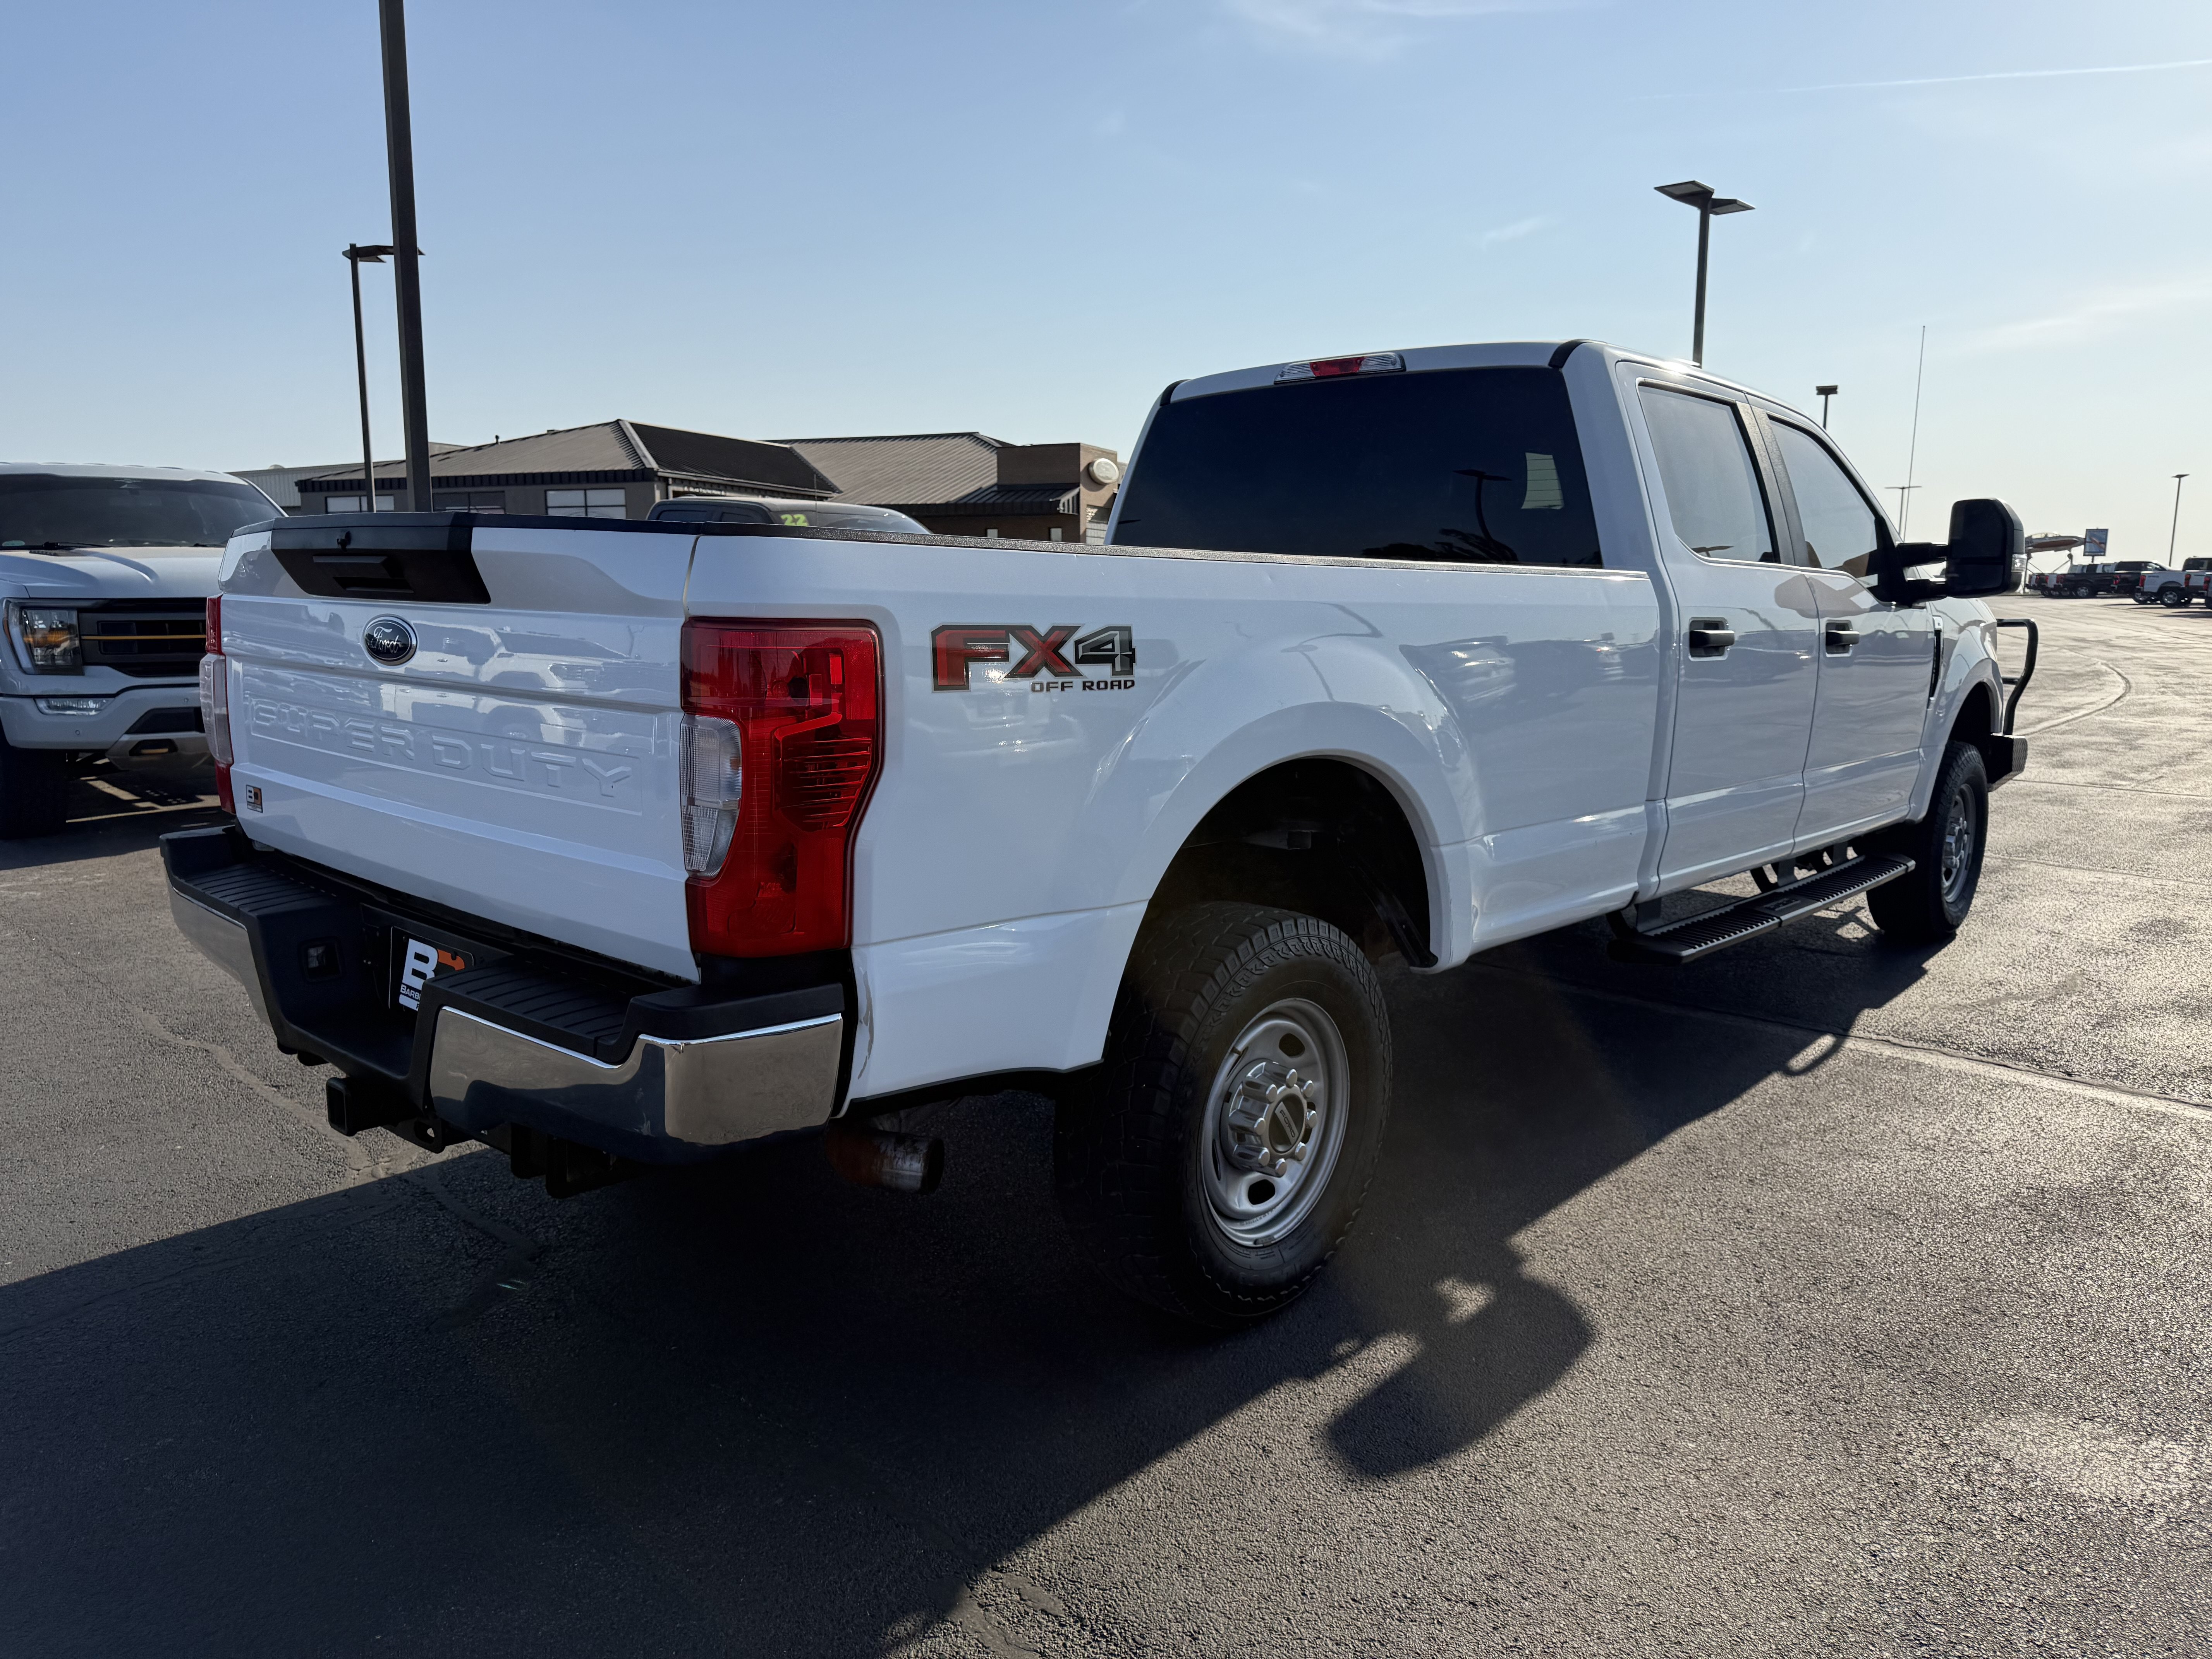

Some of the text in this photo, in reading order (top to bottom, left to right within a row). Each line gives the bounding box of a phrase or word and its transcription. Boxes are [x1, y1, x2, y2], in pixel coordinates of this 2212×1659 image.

[780, 514, 809, 526] 22
[368, 626, 403, 653] Ford
[930, 624, 1136, 692] FX4
[1031, 680, 1135, 693] OFF ROAD
[432, 735, 632, 798] DUTY
[400, 984, 421, 1001] BARB
[1279, 1109, 1295, 1138] FORD
